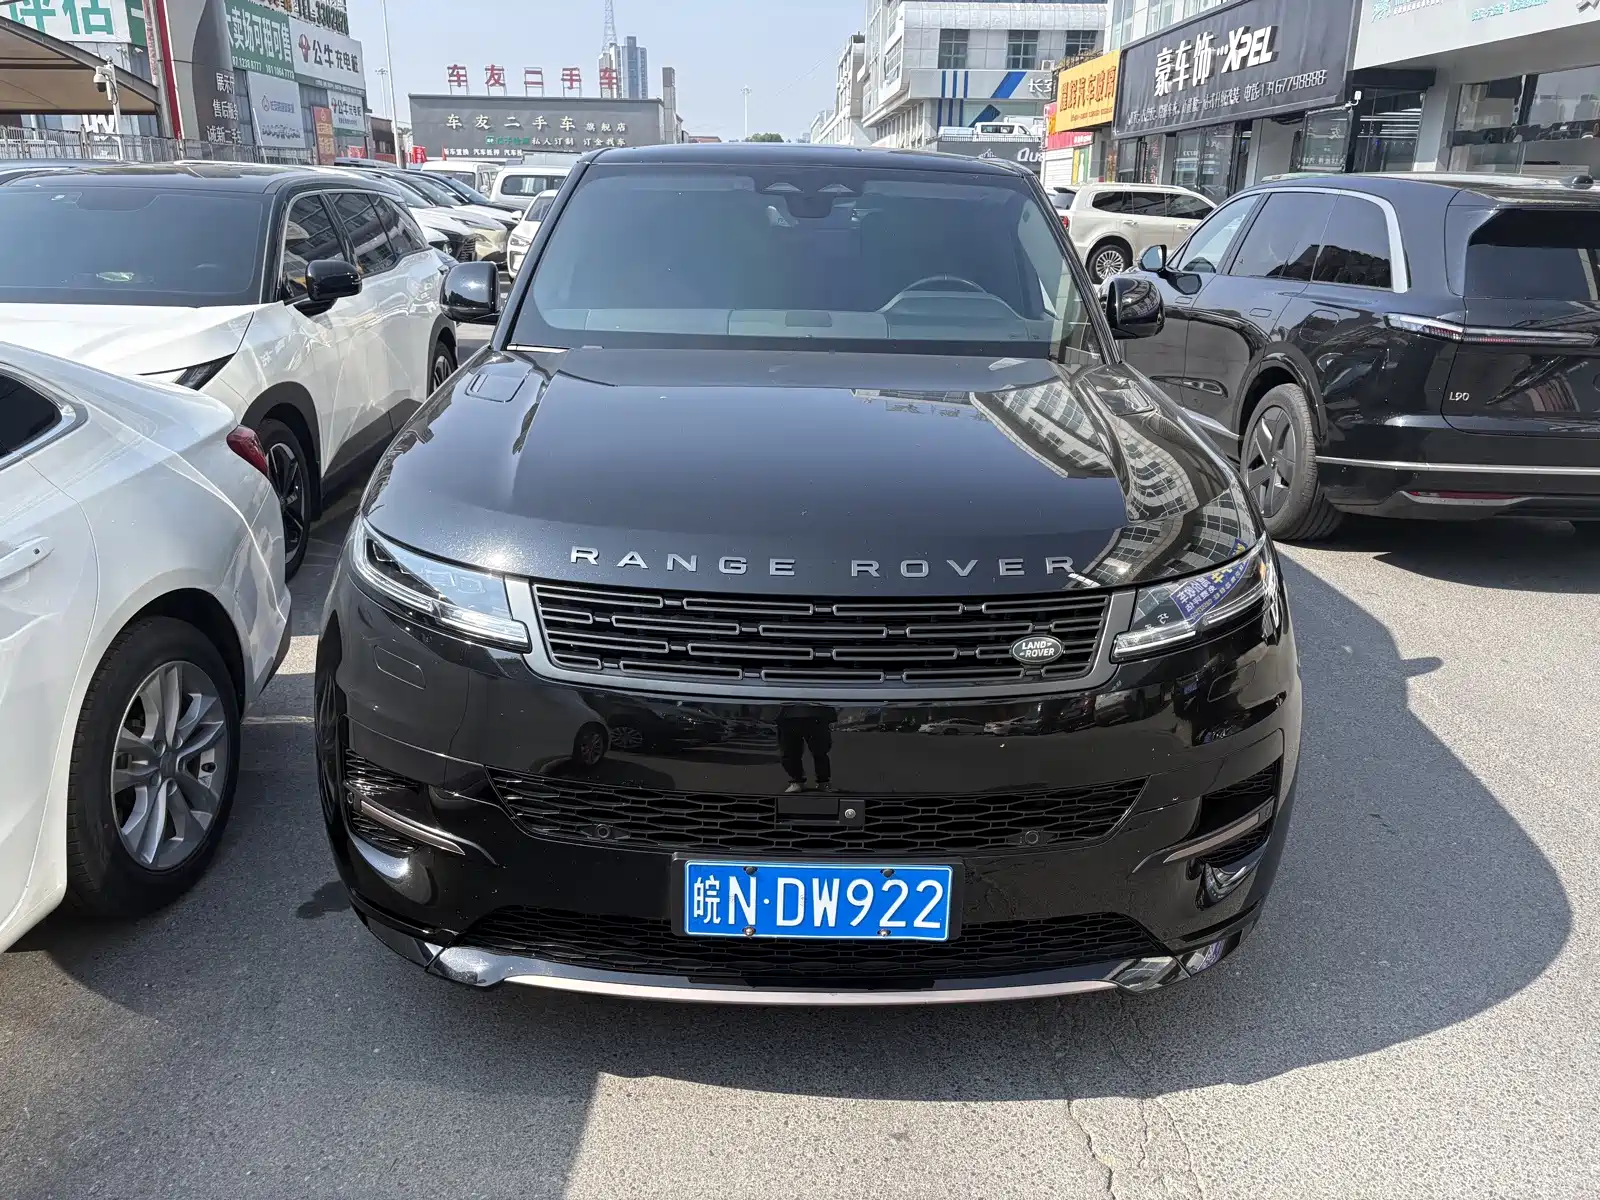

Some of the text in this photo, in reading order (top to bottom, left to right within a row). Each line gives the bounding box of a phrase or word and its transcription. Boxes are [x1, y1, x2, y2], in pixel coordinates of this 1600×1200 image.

[9, 0, 115, 35] 评估
[1153, 26, 1274, 97] 豪车饰 XPEL
[447, 64, 617, 89] 车友二手车
[213, 98, 239, 121] 售后服务
[446, 113, 627, 132] 车友二手车 旗舰店
[531, 137, 574, 146] 私人订制
[1449, 391, 1470, 401] L90
[570, 545, 1075, 578] RANGE ROVER
[1022, 641, 1046, 650] LAND
[1025, 647, 1055, 658] ROVER
[693, 874, 944, 929] 皖N·DW922
